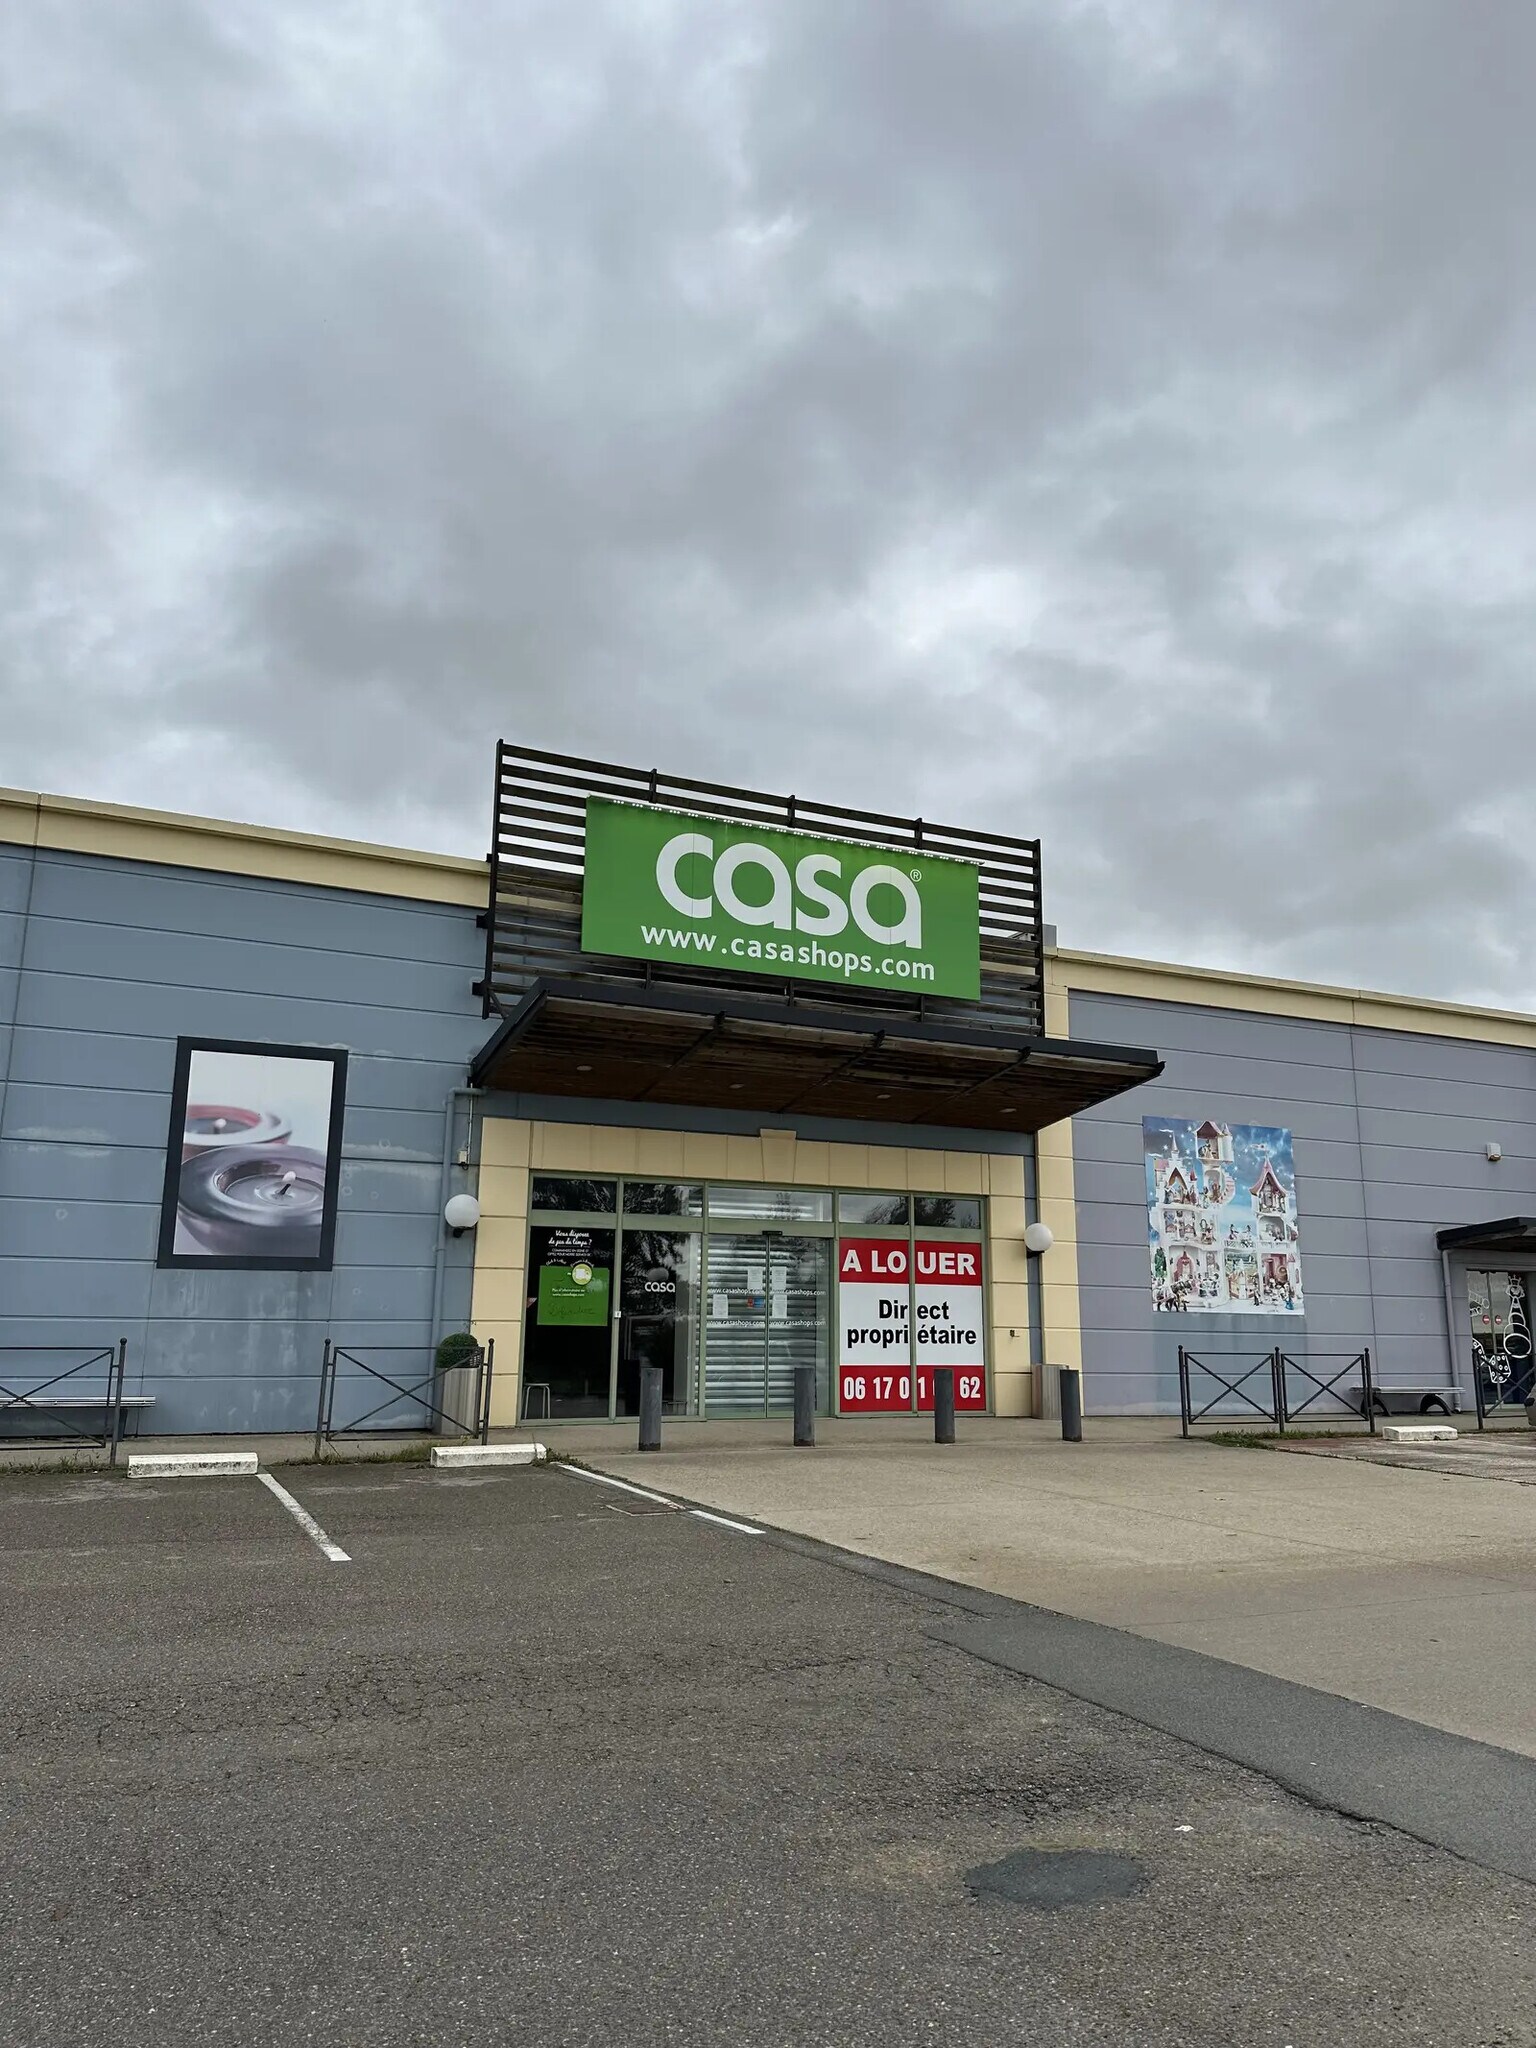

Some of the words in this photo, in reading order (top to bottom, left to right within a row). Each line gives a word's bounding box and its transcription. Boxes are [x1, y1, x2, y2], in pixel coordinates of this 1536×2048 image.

[656, 832, 922, 950] casa
[640, 925, 935, 981] www.casashops.com
[842, 1249, 862, 1272] A
[644, 1281, 676, 1293] casa
[879, 1299, 949, 1320] Direct
[847, 1324, 977, 1349] propriétaire
[843, 1376, 866, 1400] 06
[873, 1376, 893, 1400] 17
[959, 1376, 981, 1399] 62
